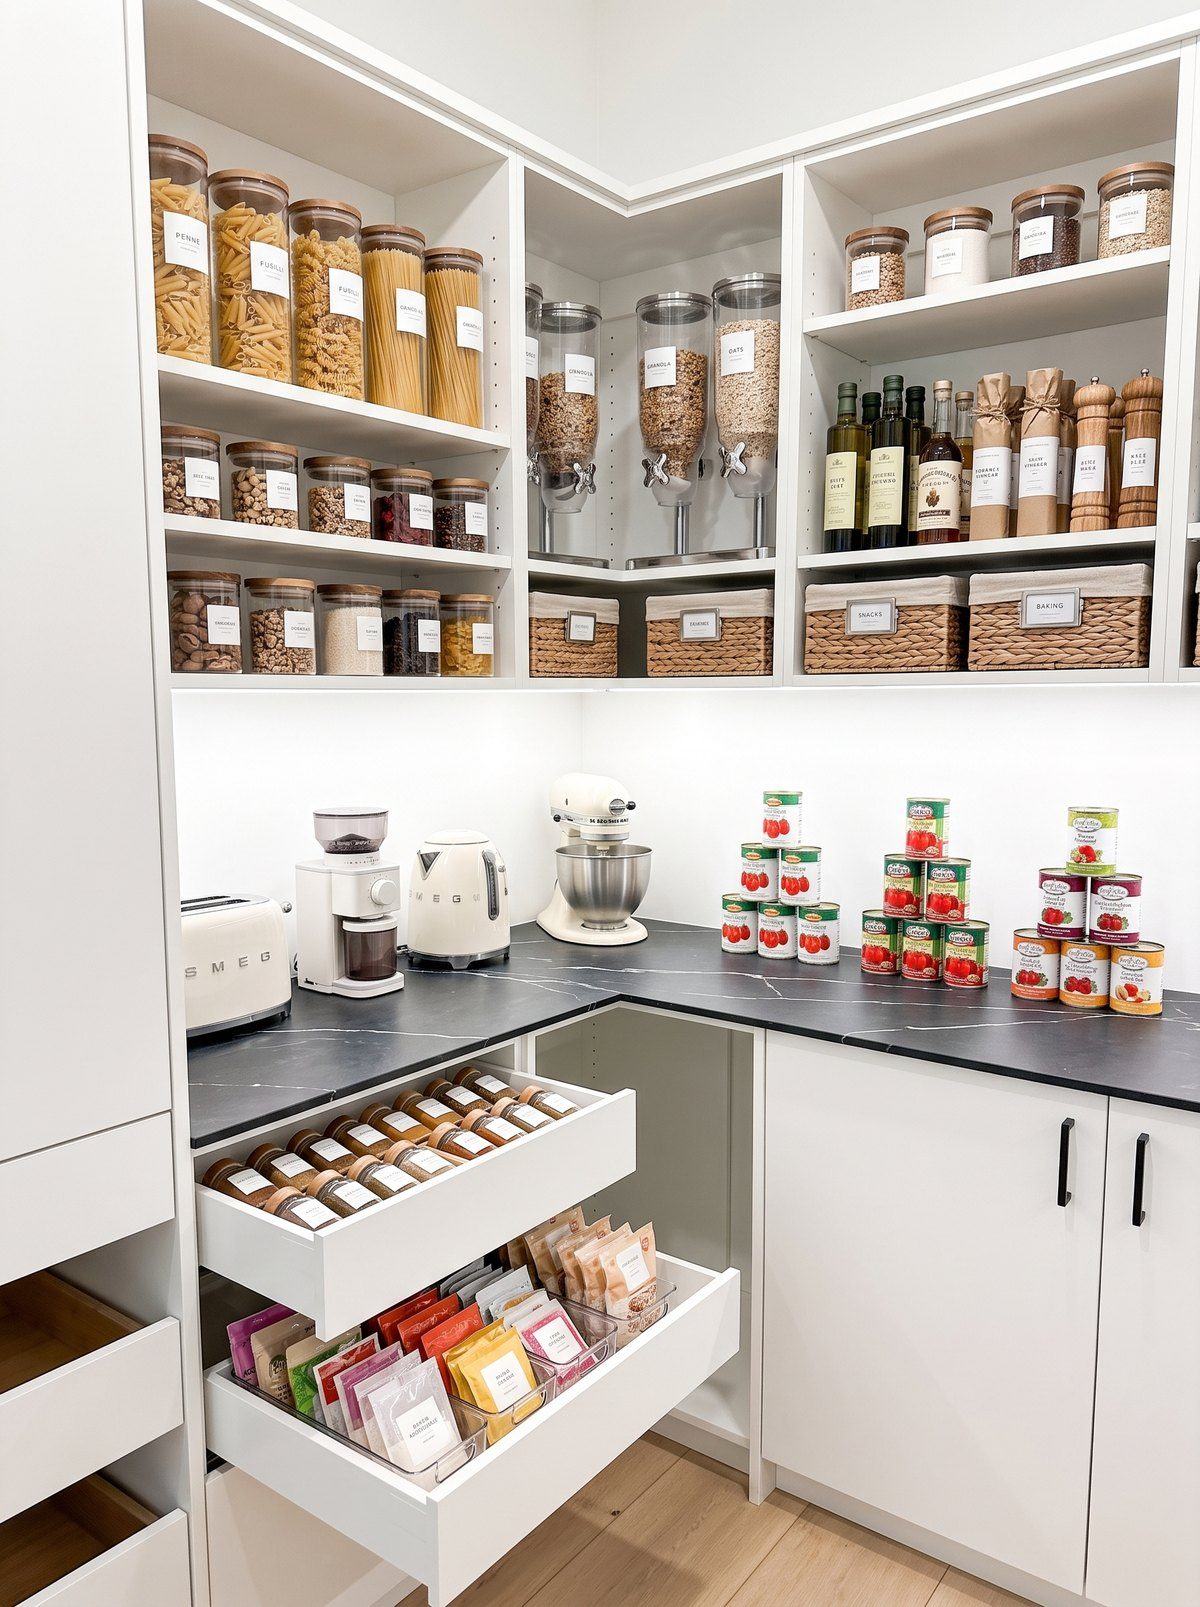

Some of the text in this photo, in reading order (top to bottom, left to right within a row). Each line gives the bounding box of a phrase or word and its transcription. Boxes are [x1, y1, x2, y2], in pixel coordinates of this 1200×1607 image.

[176, 232, 200, 245] PENNE
[260, 261, 284, 273] FUSILLI
[647, 361, 671, 370] GRANOLA
[1036, 602, 1064, 611] BAKING
[858, 611, 883, 619] SNACKS
[184, 951, 272, 979] SMEG
